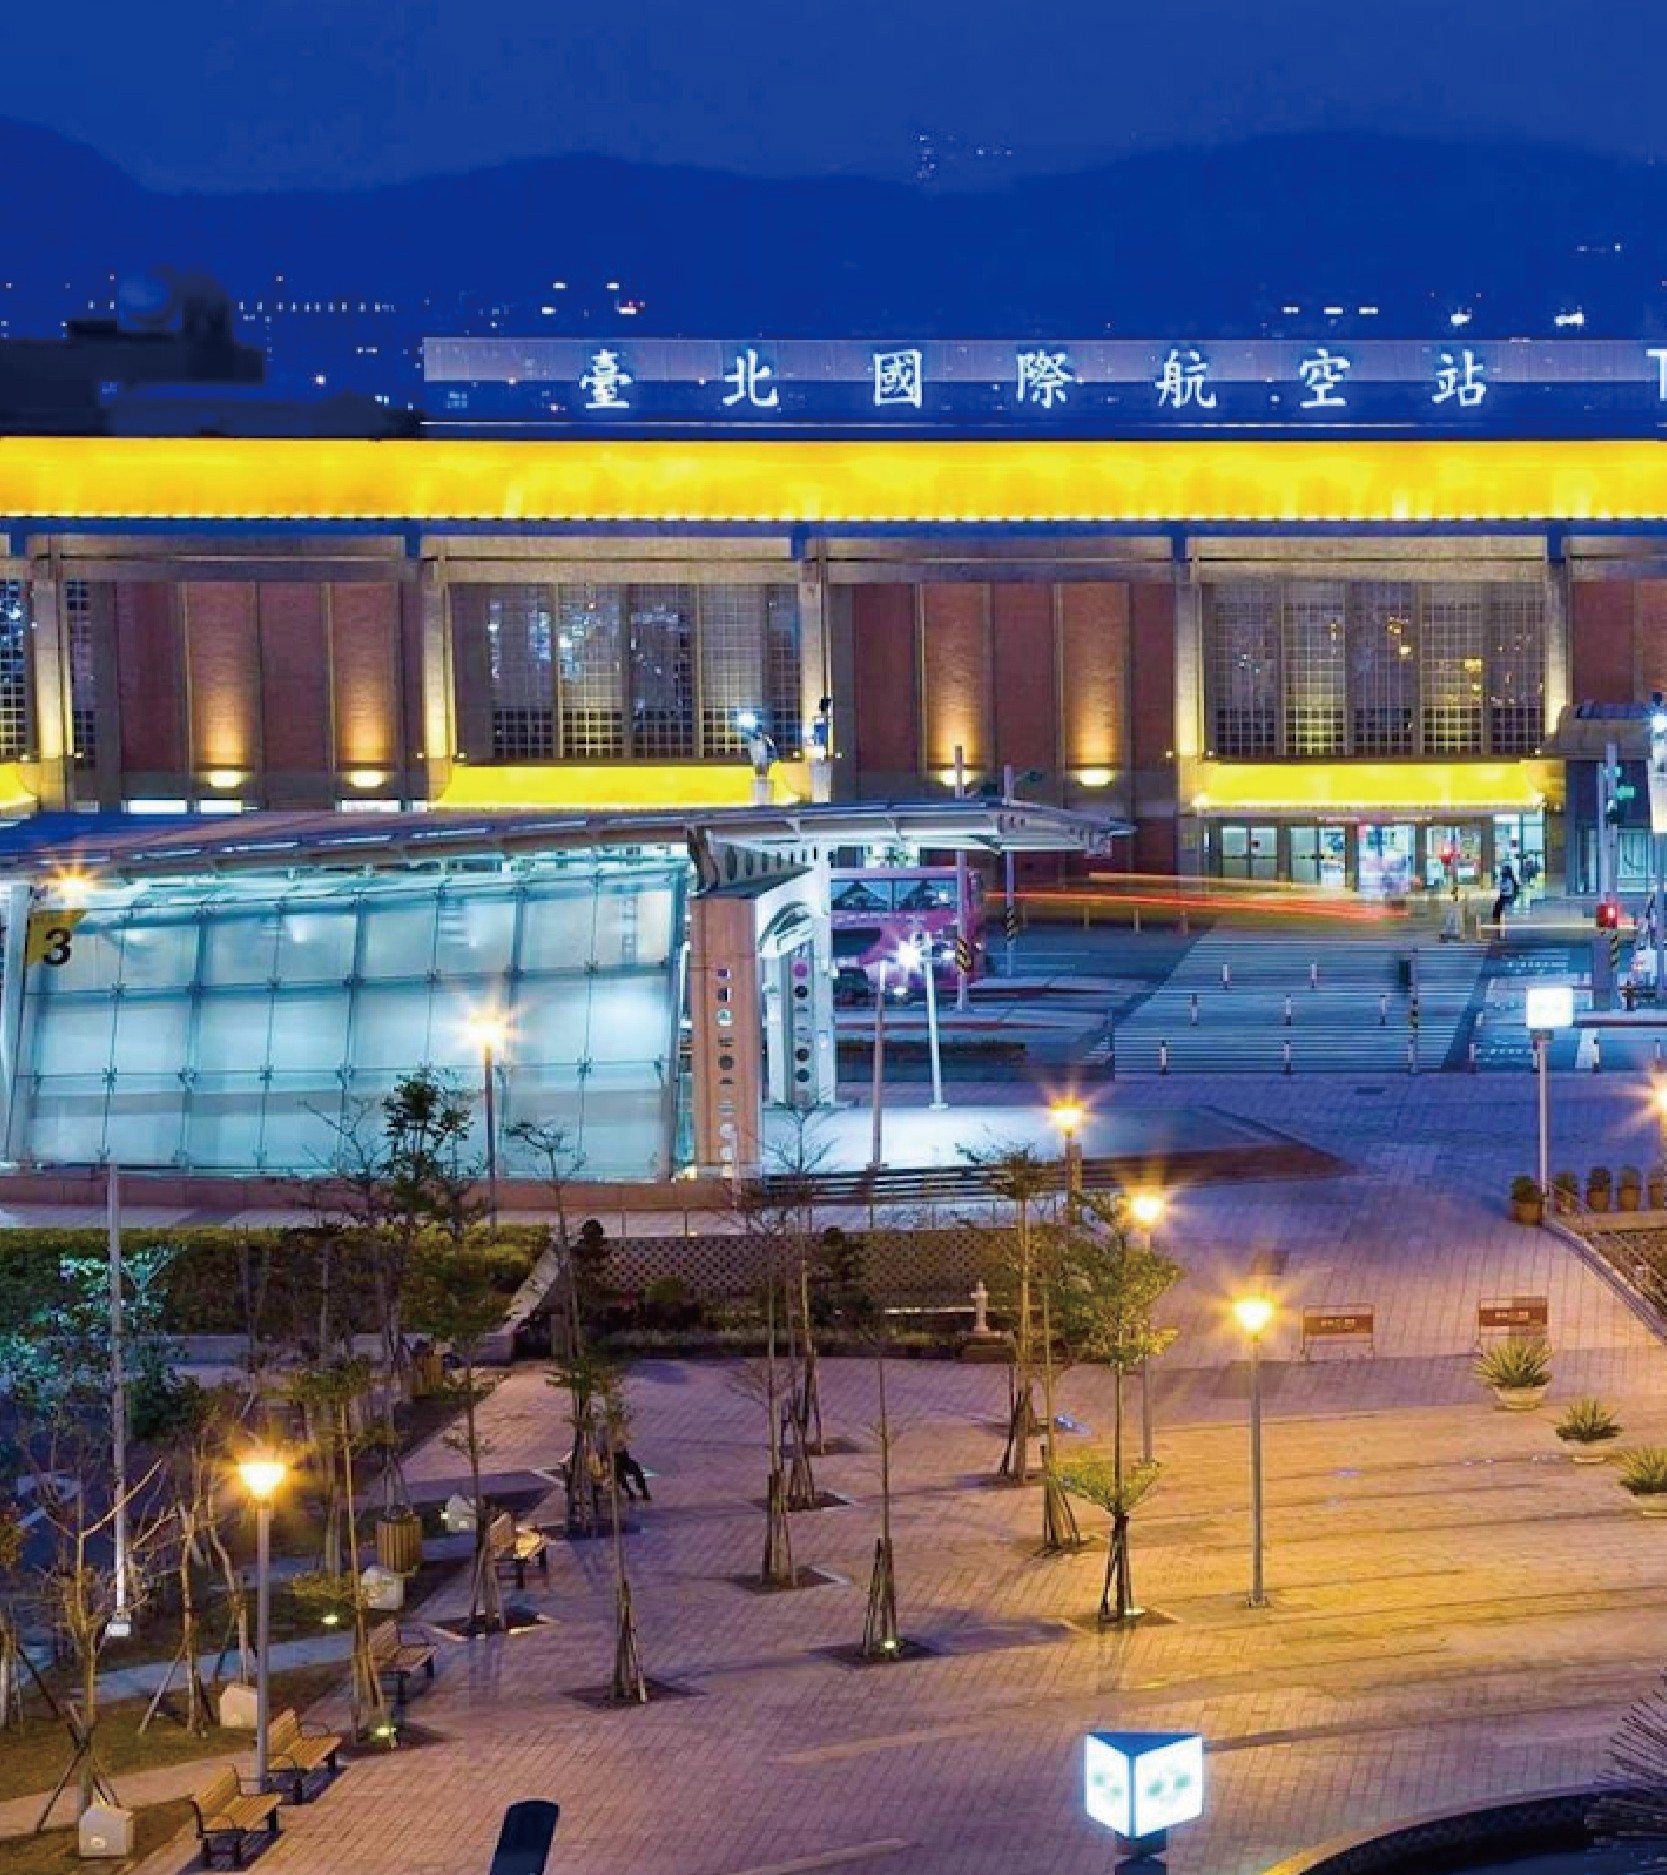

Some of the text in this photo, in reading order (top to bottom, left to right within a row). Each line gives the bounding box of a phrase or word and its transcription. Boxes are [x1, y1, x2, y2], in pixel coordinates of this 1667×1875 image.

[580, 348, 1487, 409] 臺北國際航空站
[43, 926, 73, 966] 3
